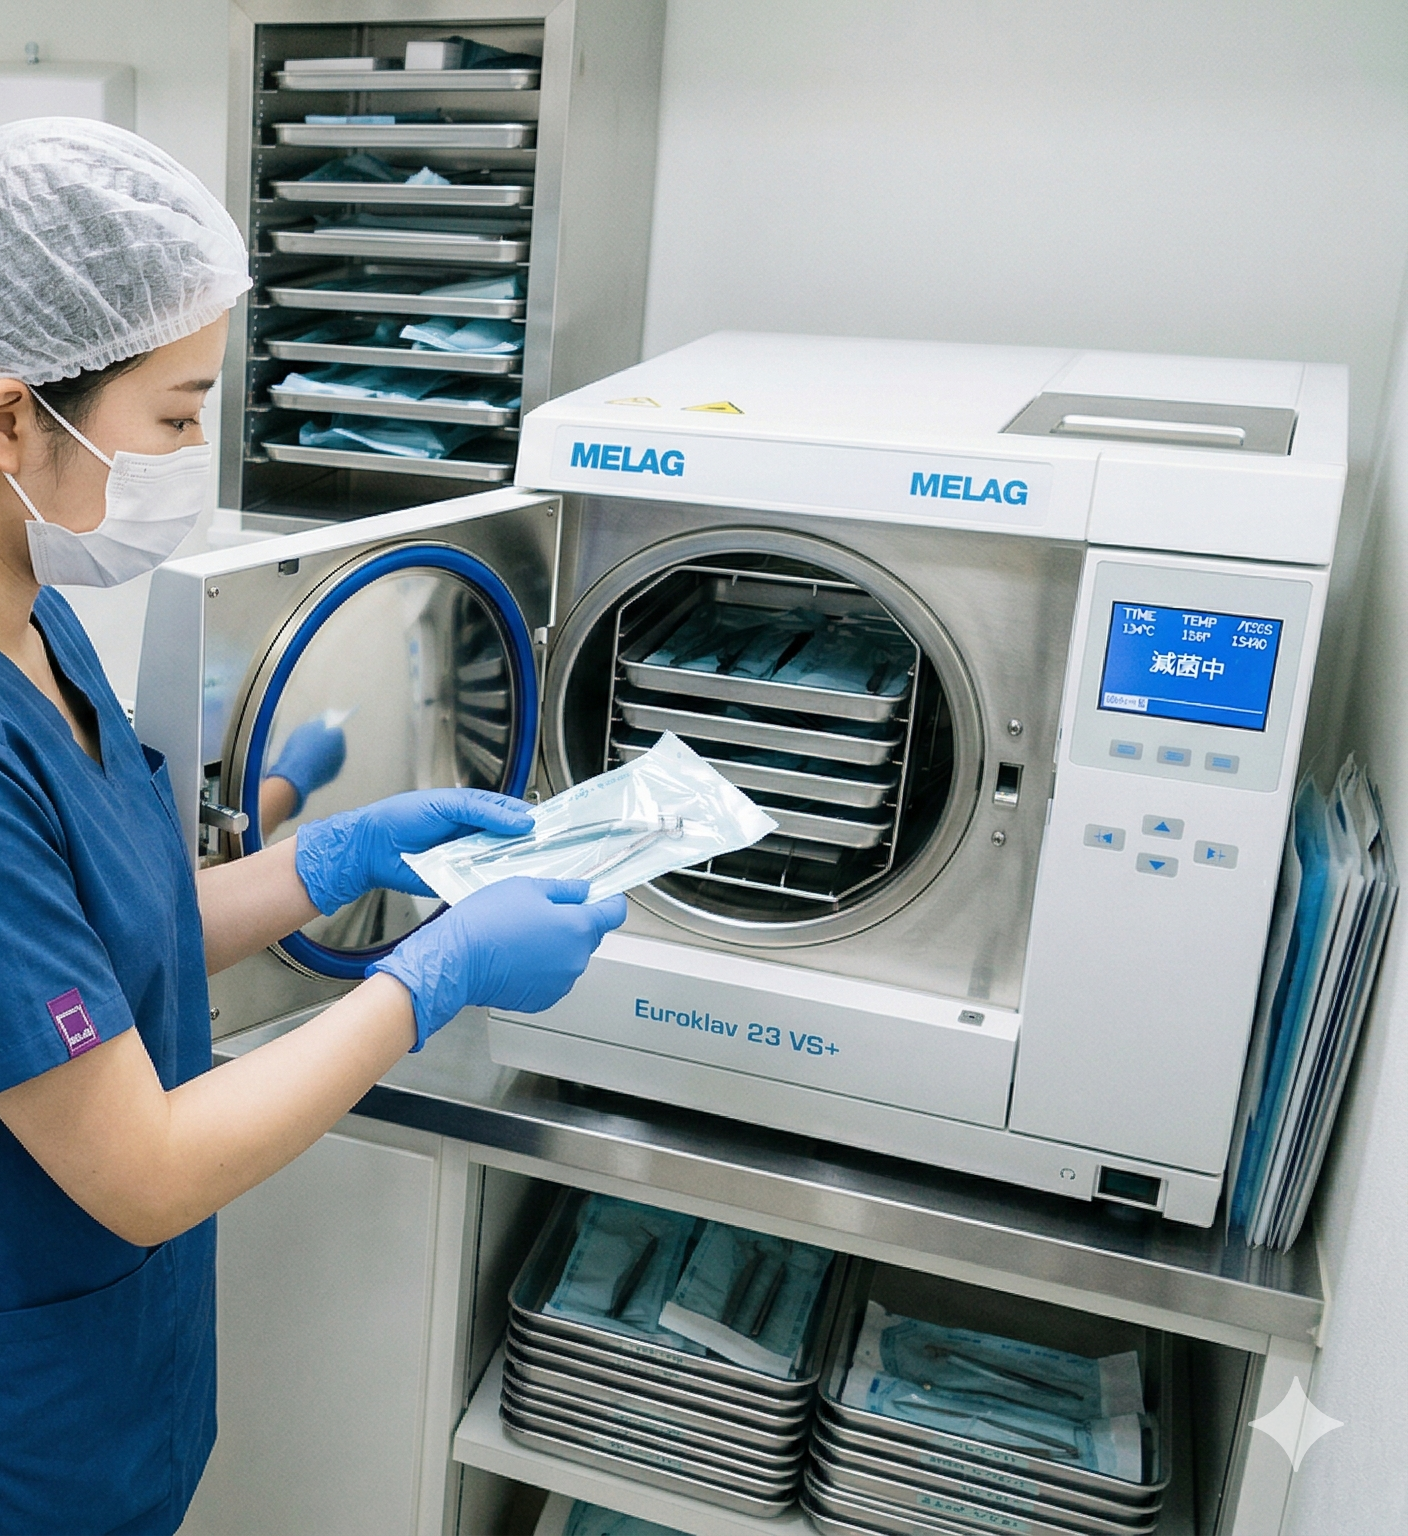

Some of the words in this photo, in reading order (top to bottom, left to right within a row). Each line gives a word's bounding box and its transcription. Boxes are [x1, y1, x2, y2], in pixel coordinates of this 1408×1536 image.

[570, 442, 686, 477] MELAG
[910, 472, 1028, 505] MELAG
[1123, 607, 1157, 622] TIME
[1182, 614, 1217, 628] TEMP
[635, 998, 738, 1038] Euroklav
[747, 1023, 781, 1047] 23
[789, 1031, 840, 1056] VS+
